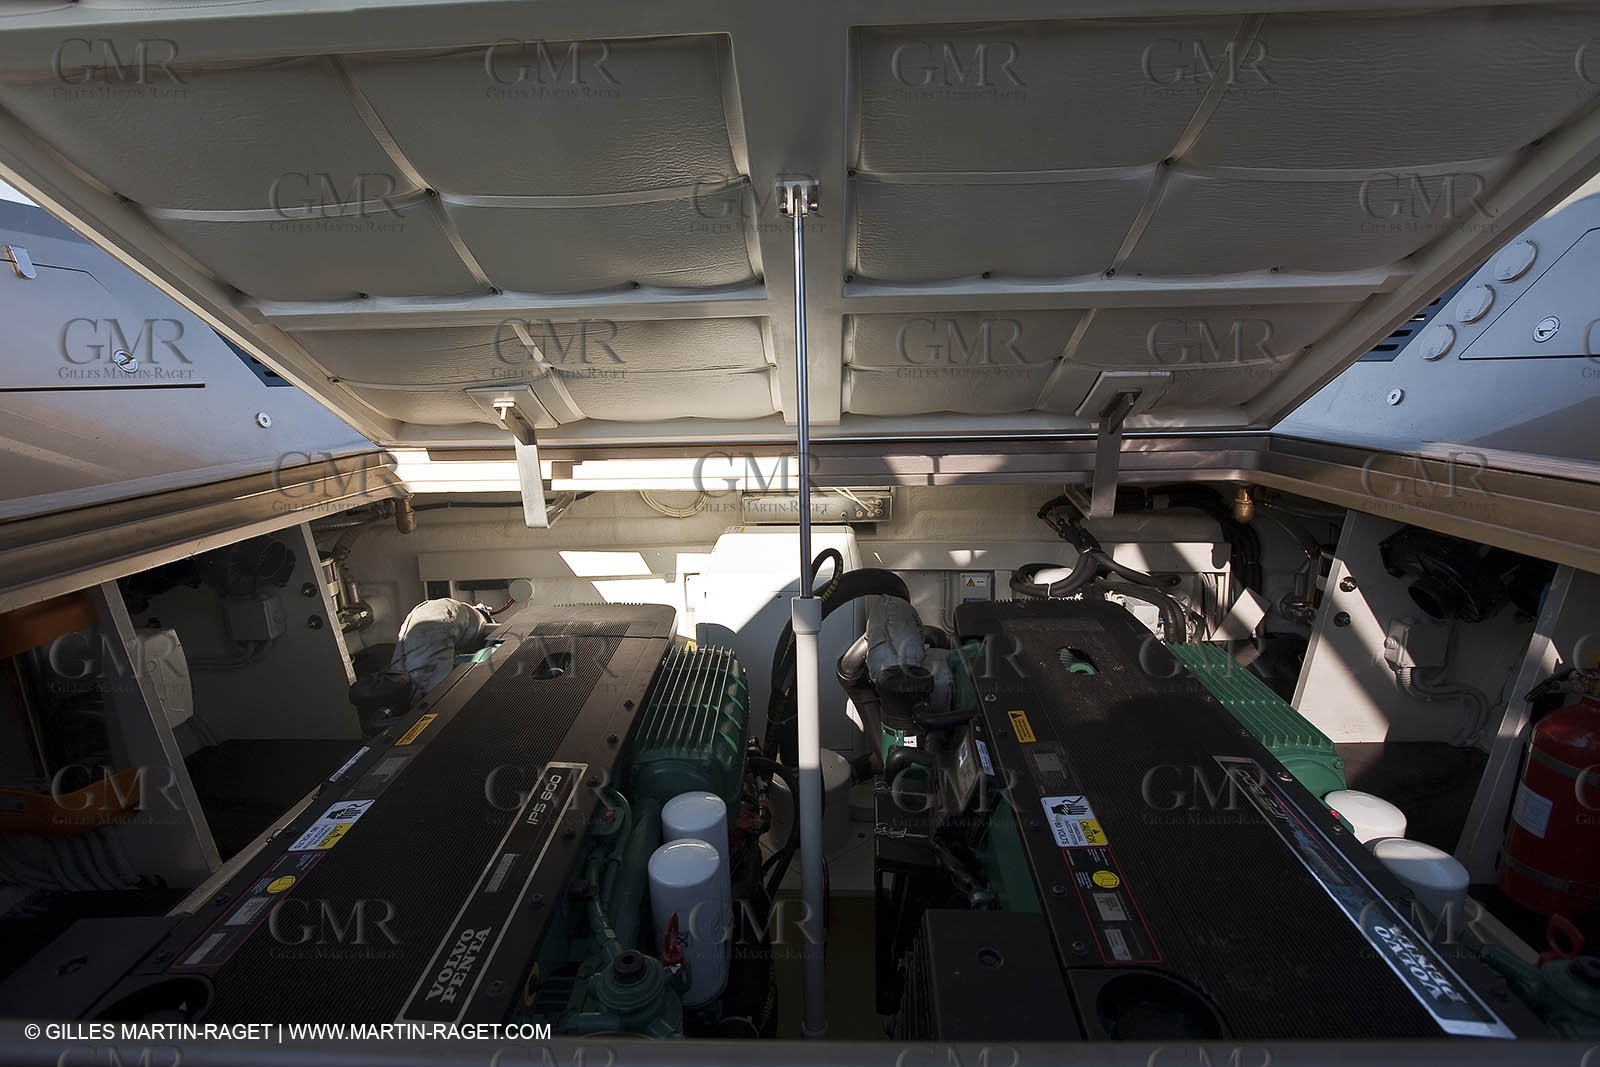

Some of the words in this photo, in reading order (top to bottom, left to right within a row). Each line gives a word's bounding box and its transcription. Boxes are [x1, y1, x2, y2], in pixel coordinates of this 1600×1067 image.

[526, 802, 547, 825] IPS
[540, 774, 562, 801] 600
[425, 929, 475, 1000] VOLVO
[440, 926, 492, 1003] PENTA
[1374, 925, 1443, 1000] VOLVO
[1389, 923, 1468, 1003] PENTA
